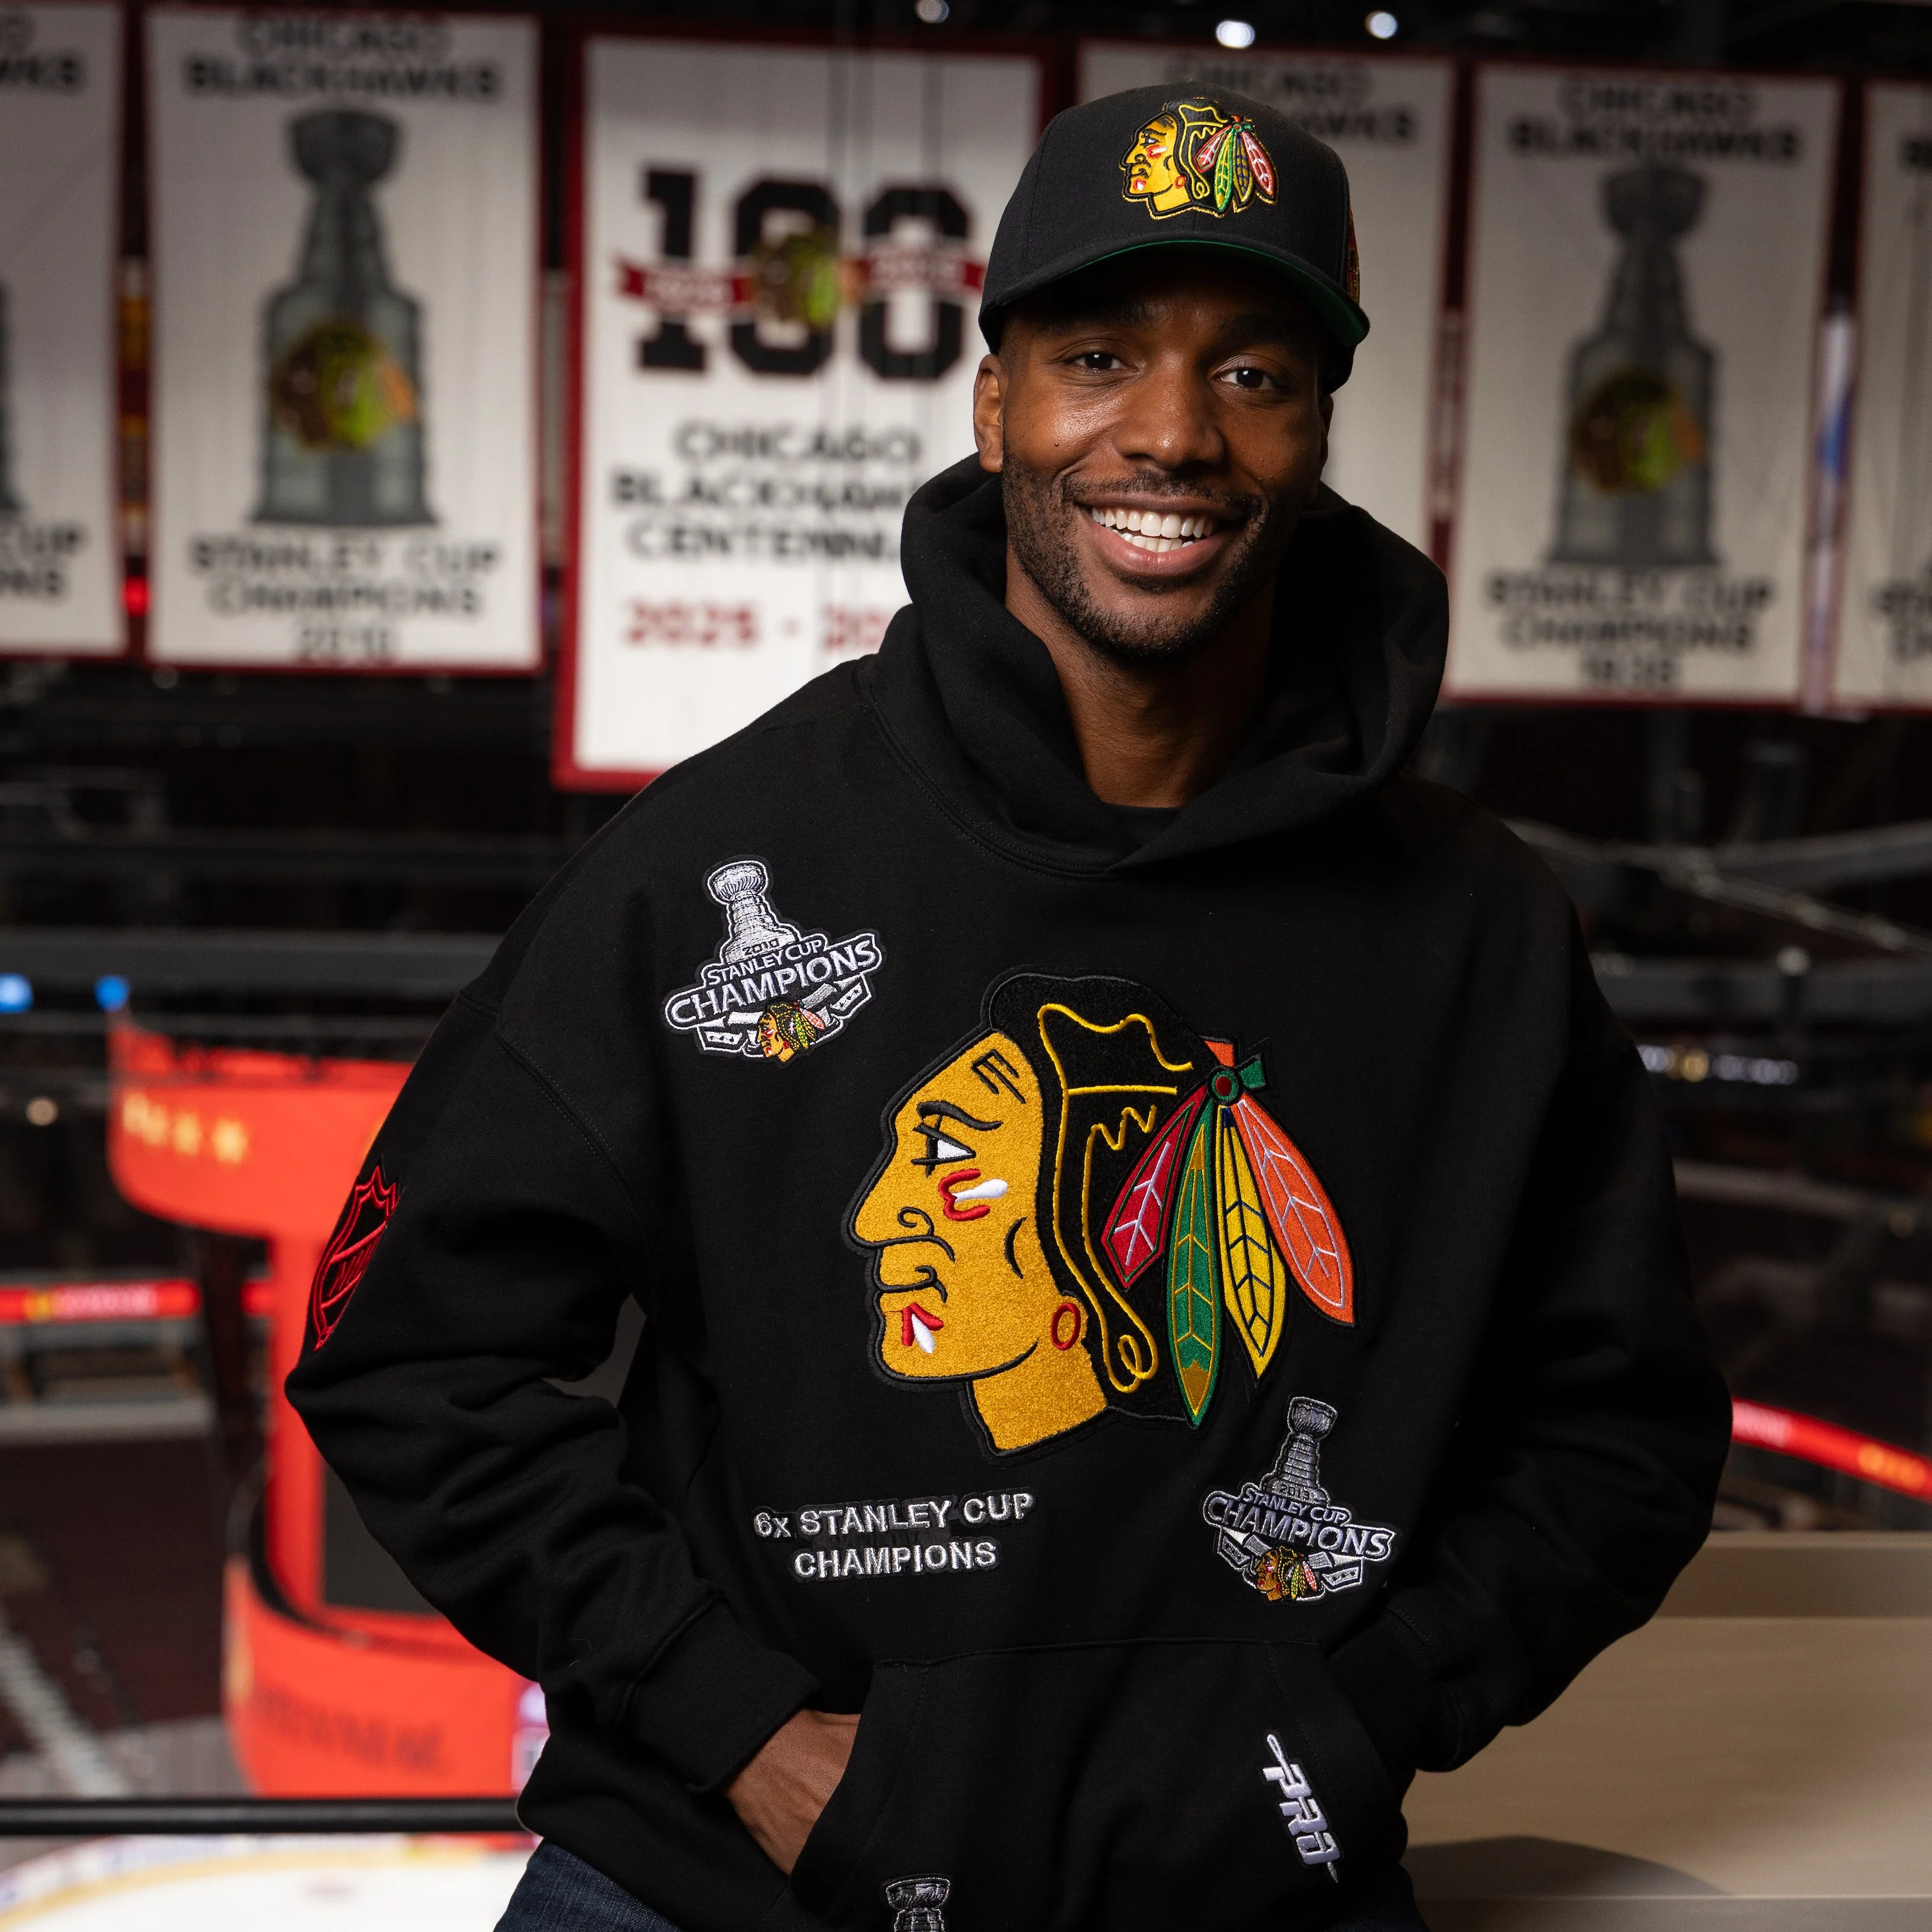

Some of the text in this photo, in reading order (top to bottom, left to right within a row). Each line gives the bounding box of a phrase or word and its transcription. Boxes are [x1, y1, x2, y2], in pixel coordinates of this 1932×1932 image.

[637, 161, 972, 382] 100
[673, 423, 921, 462] CHICAGO
[707, 939, 822, 985] STANLEY CUP
[742, 938, 779, 958] 2010
[671, 940, 876, 1024] CHAMPIONS
[753, 1492, 1034, 1538] 6x STANLEY CUP
[1208, 1497, 1390, 1556] CHAMPIONS
[1243, 1488, 1348, 1524] STANLEY CUP
[794, 1541, 997, 1578] CHAMPIONS
